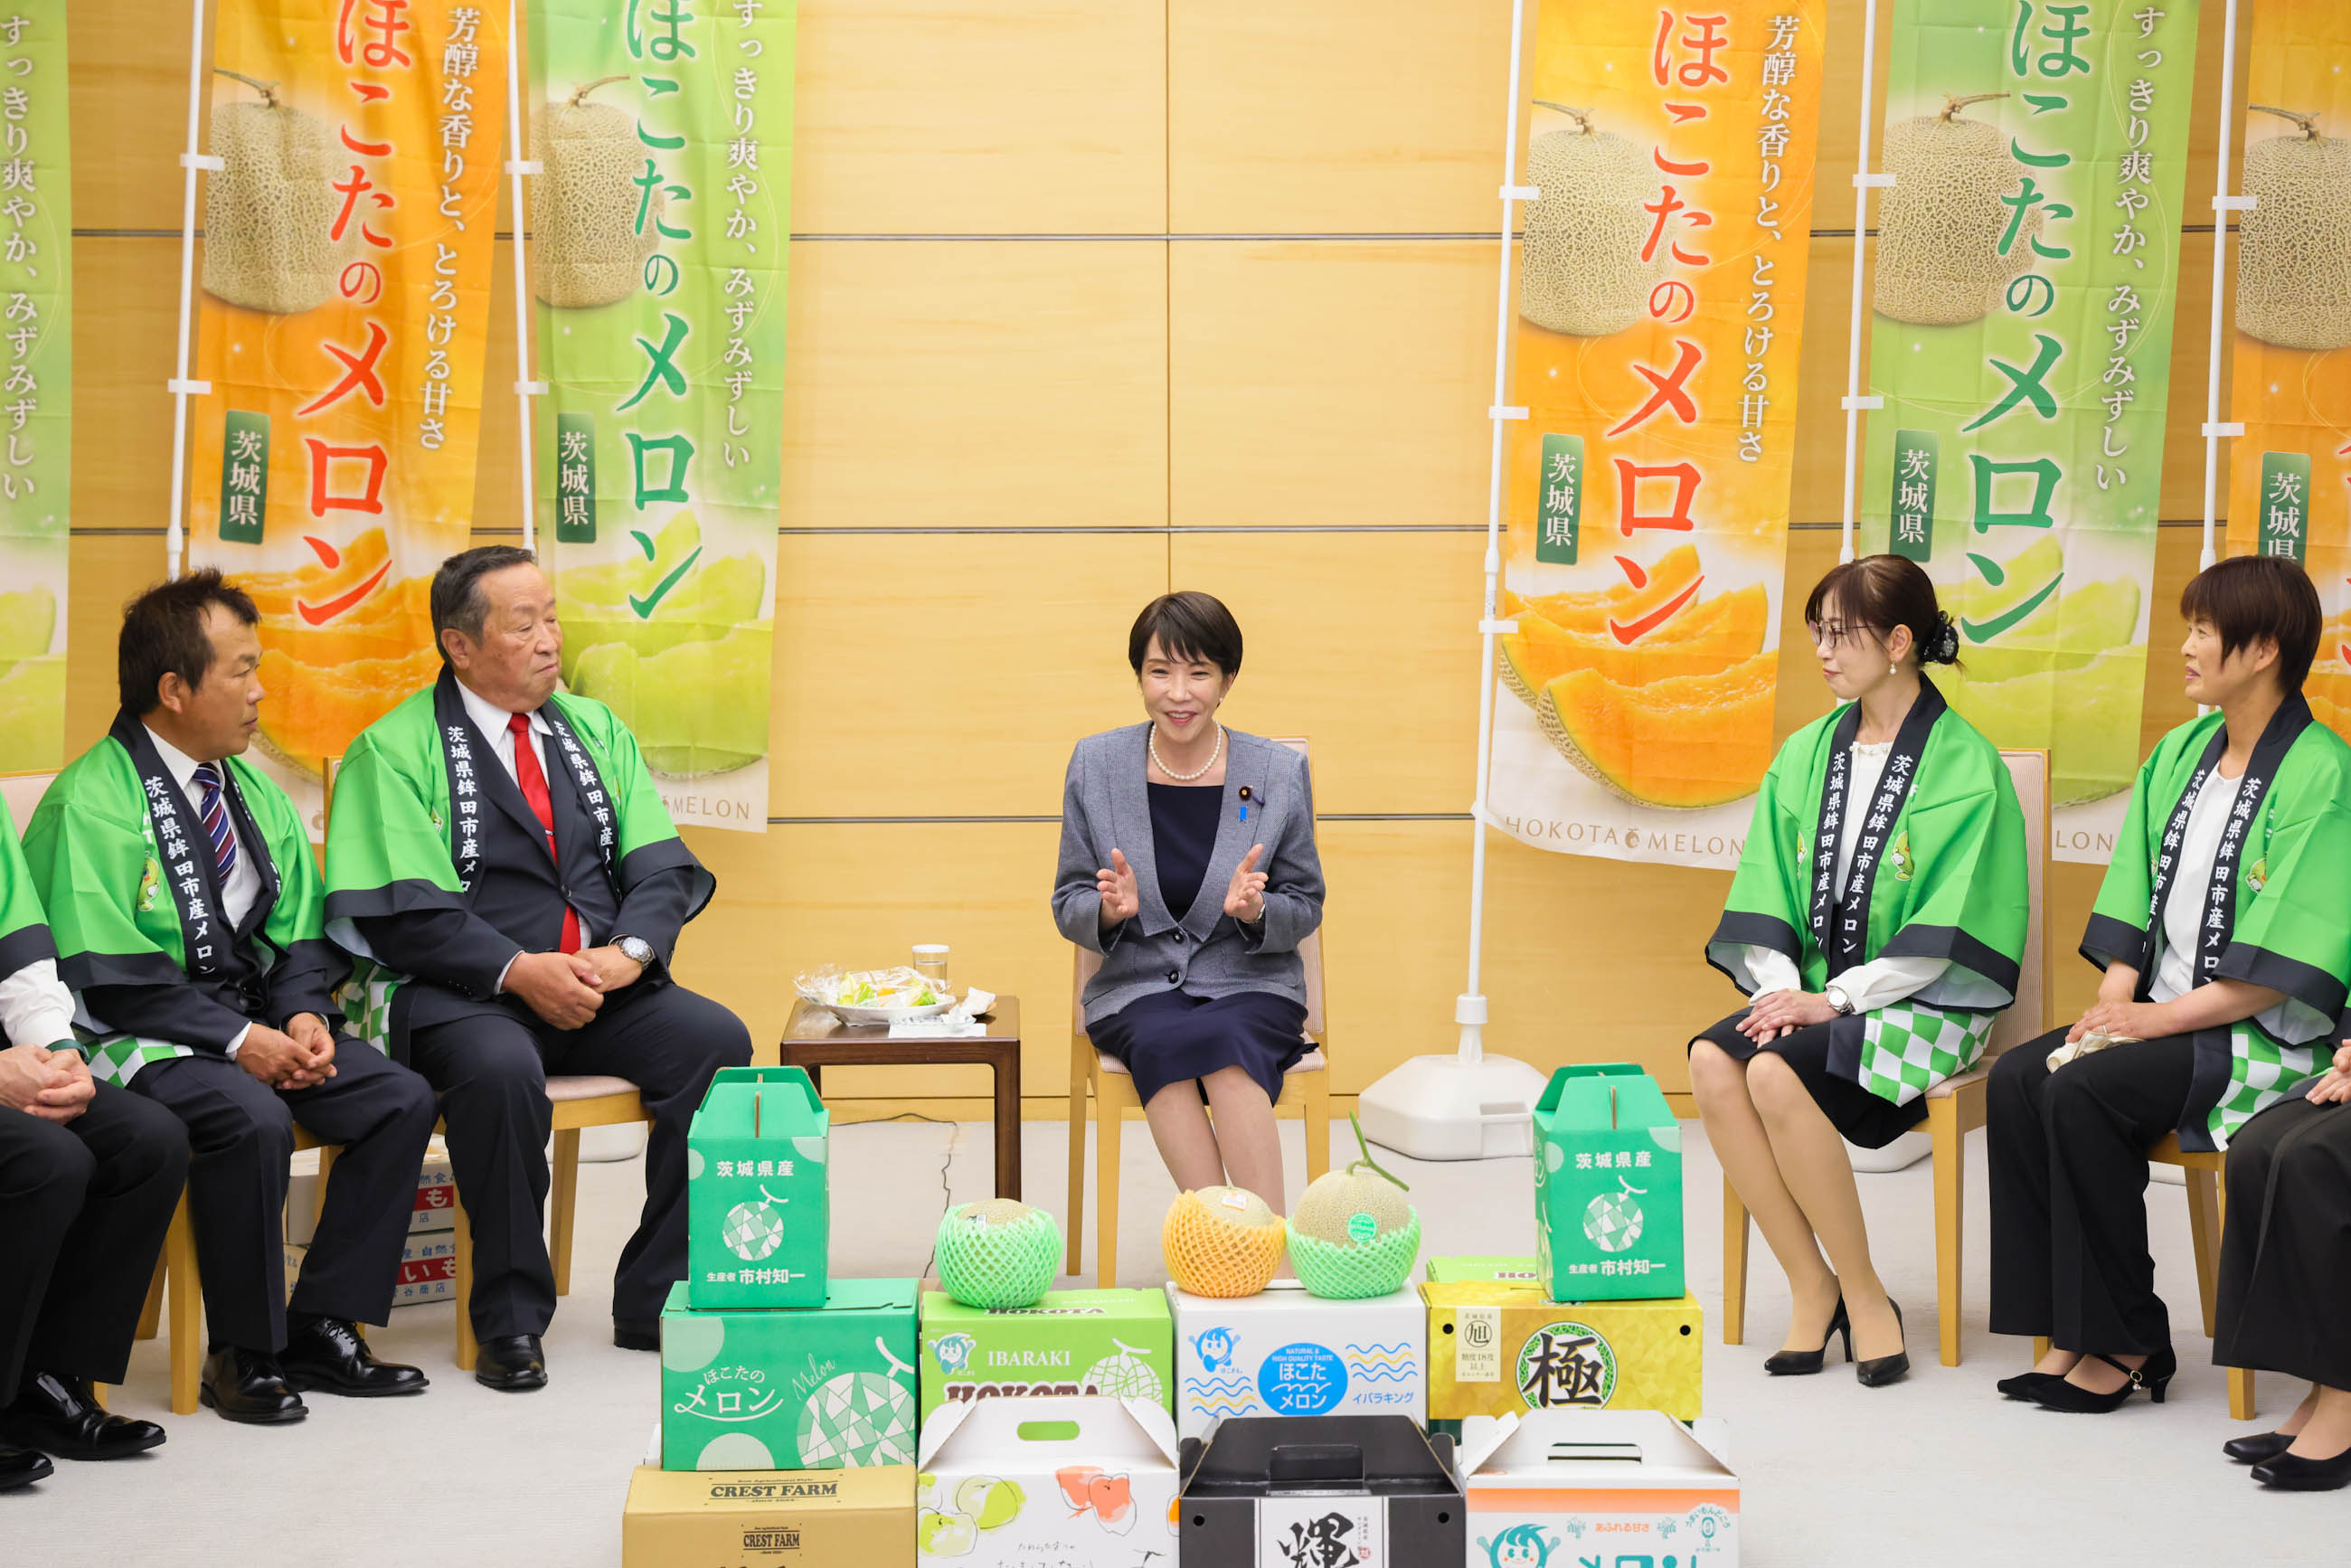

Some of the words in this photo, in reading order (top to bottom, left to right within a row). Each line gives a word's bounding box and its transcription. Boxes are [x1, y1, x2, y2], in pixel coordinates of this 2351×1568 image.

[418, 7, 481, 450] 芳醇な香りと、とろける甘さ
[722, 0, 763, 468] すっきり爽やか、みずみずしい
[1737, 15, 1800, 463] 芳醇な香りと、とろける甘さ
[2095, 7, 2165, 490] すっきり爽やか、みずみずしい
[0, 15, 38, 499] すっきり爽やか、みずみずしい
[297, 0, 411, 627] ほこたのメロン
[616, 0, 703, 620] ほこたのメロン
[1608, 10, 1729, 645] ほこたのメロン
[1960, 0, 2091, 645] ほこたのメロン
[227, 430, 262, 527] 茨城県
[560, 431, 590, 527] 茨城県
[1544, 452, 1578, 548] 茨城県
[1897, 449, 1931, 544] 茨城県
[673, 797, 750, 819] MELON
[1842, 754, 1913, 954] 茨城県鉾田市産メロン
[2055, 830, 2113, 852] LON
[716, 1160, 794, 1177] 茨城県産
[1575, 1151, 1652, 1169] 茨城県産
[706, 1272, 736, 1282] 生産者
[739, 1269, 806, 1285] 市村知一
[1569, 1264, 1598, 1274] 生産者
[1600, 1260, 1666, 1276] 市村知一
[1468, 1324, 1489, 1343] 旭
[703, 1365, 765, 1384] ほこたの
[792, 1353, 836, 1401] Melon
[987, 1351, 1071, 1366] IBARAKI
[1279, 1364, 1327, 1381] ほこた
[1523, 1333, 1603, 1408] 極
[674, 1384, 784, 1422] メロン
[1279, 1394, 1327, 1410] メロン
[1353, 1392, 1414, 1404] イバラキング
[711, 1486, 776, 1497] CREST
[781, 1484, 837, 1496] FARM
[743, 1535, 772, 1547] CREST
[775, 1534, 800, 1546] FARM
[1596, 1523, 1650, 1533] あふれる甘さ
